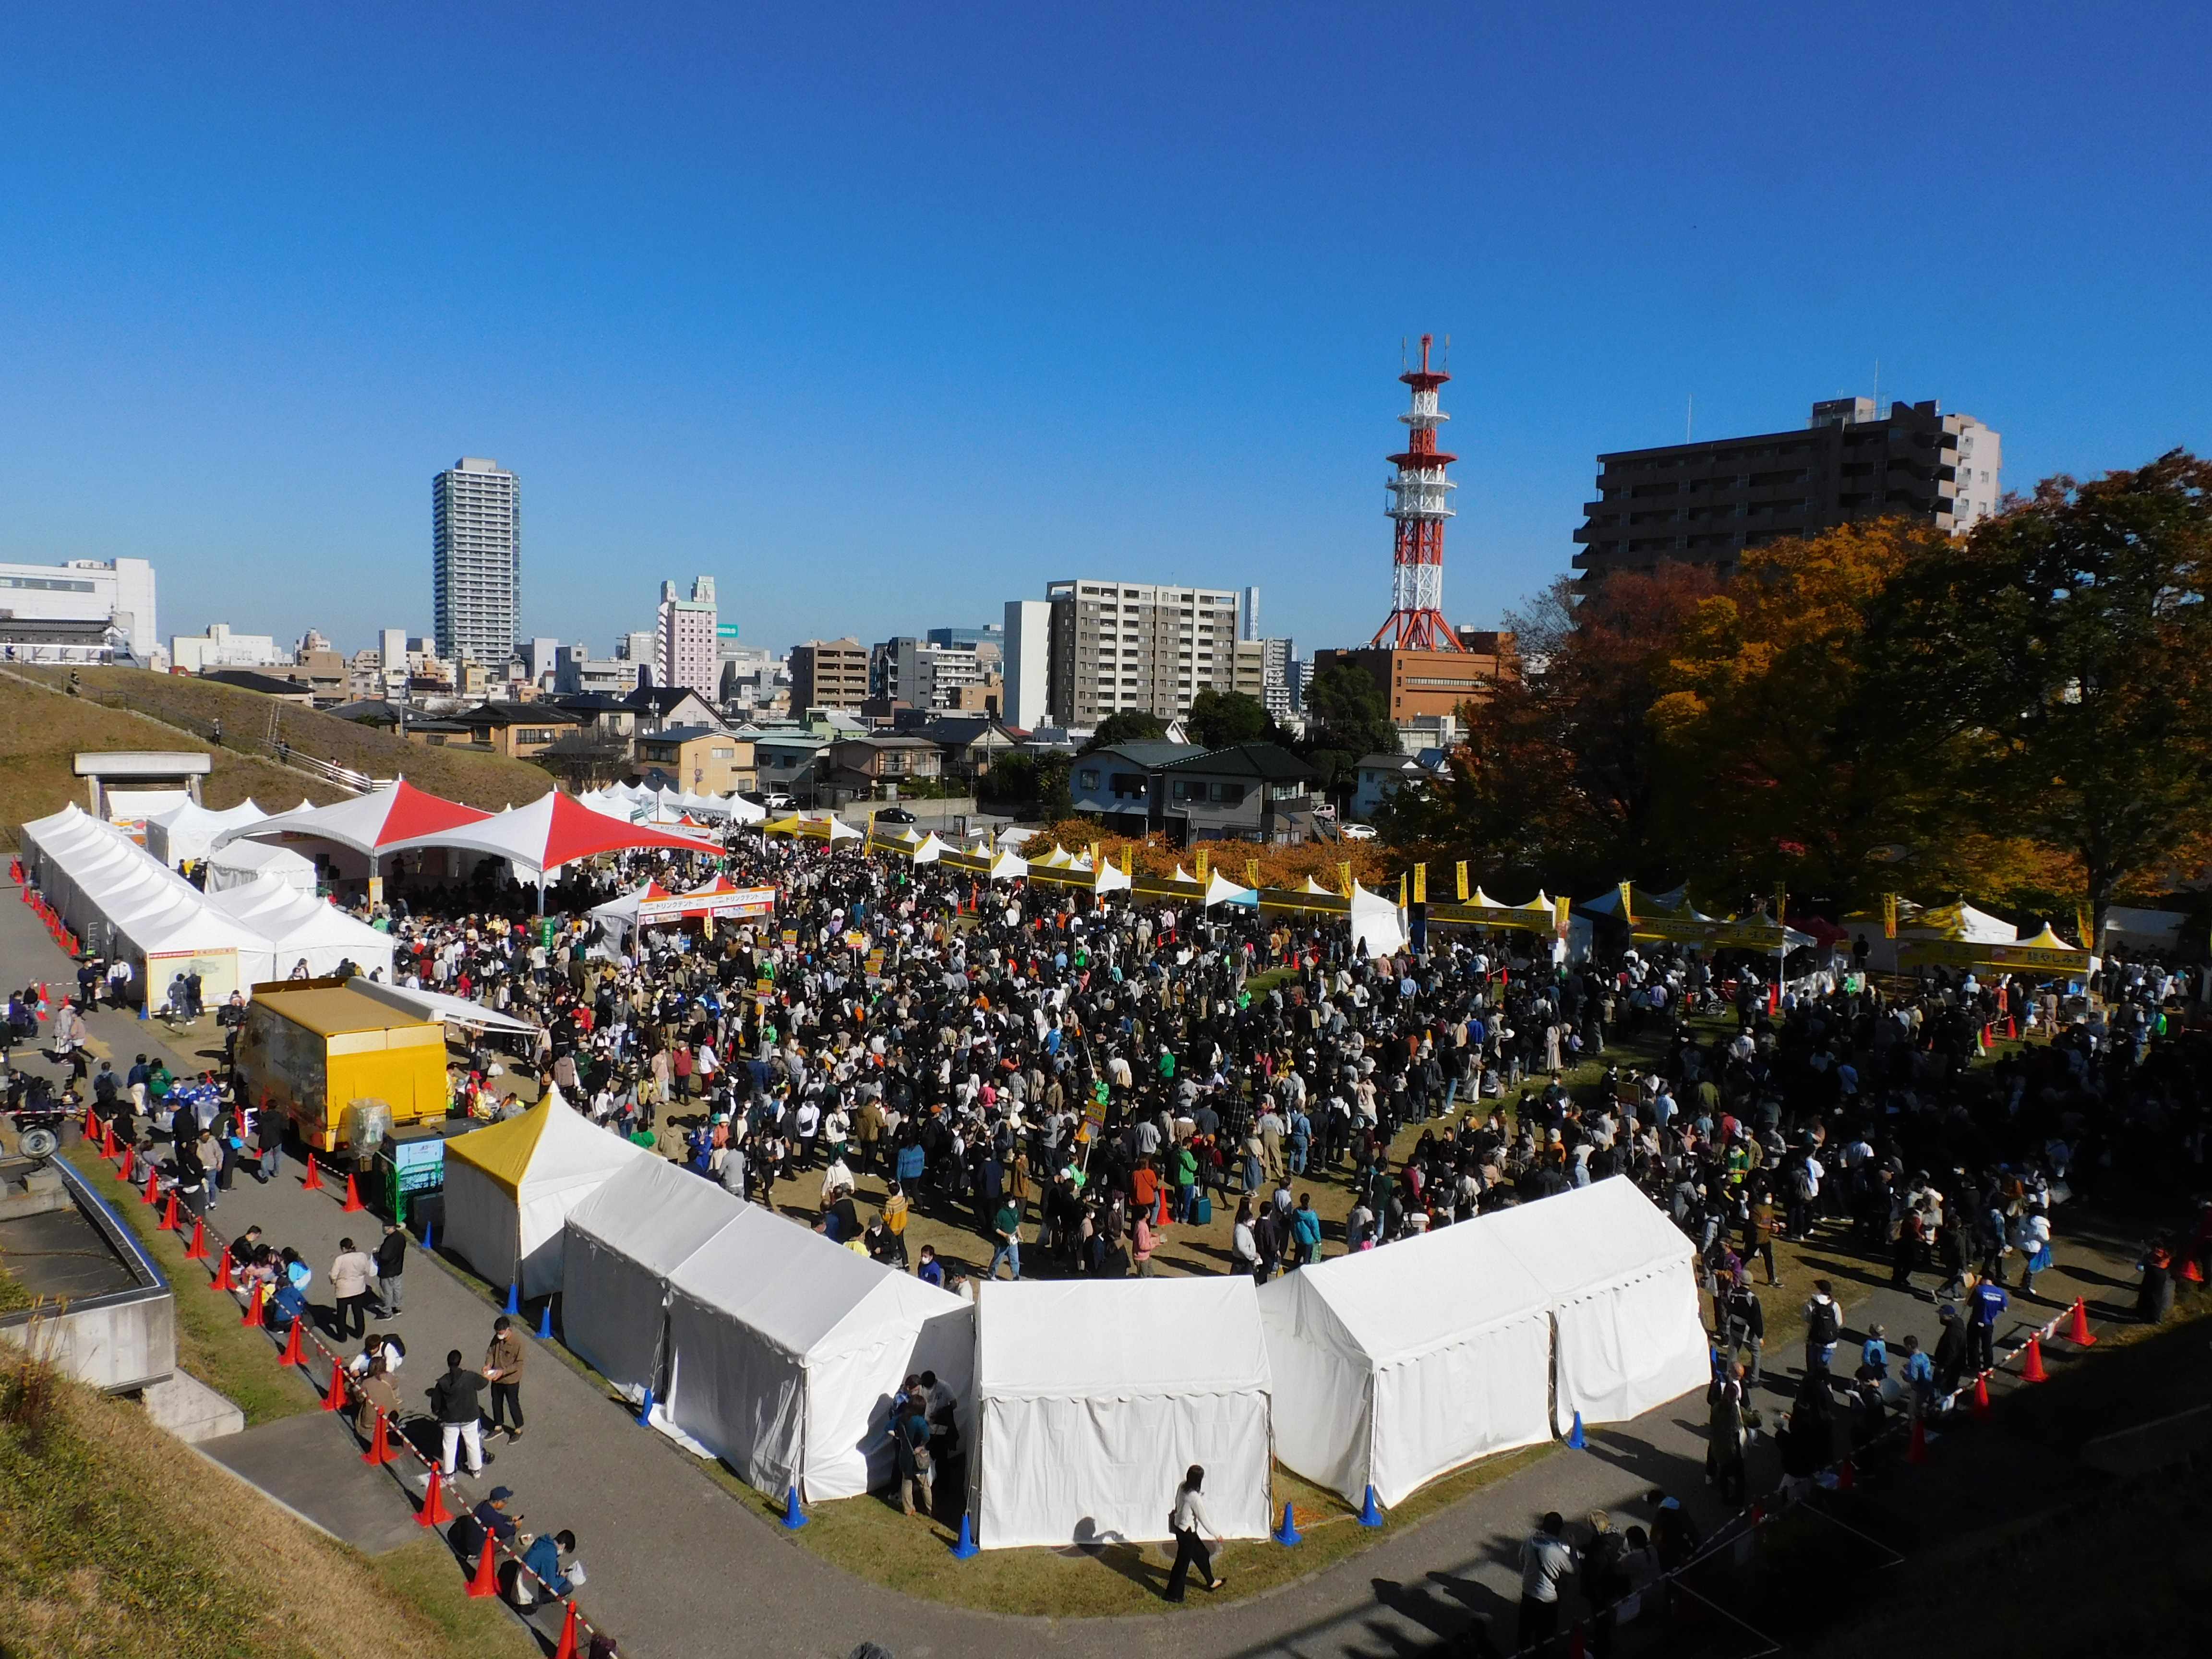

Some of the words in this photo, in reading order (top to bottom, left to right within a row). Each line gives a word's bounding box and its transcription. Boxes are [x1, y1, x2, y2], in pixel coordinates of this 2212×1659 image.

[725, 894, 759, 902] ドリンクテント
[656, 901, 693, 909] ドリンクテント
